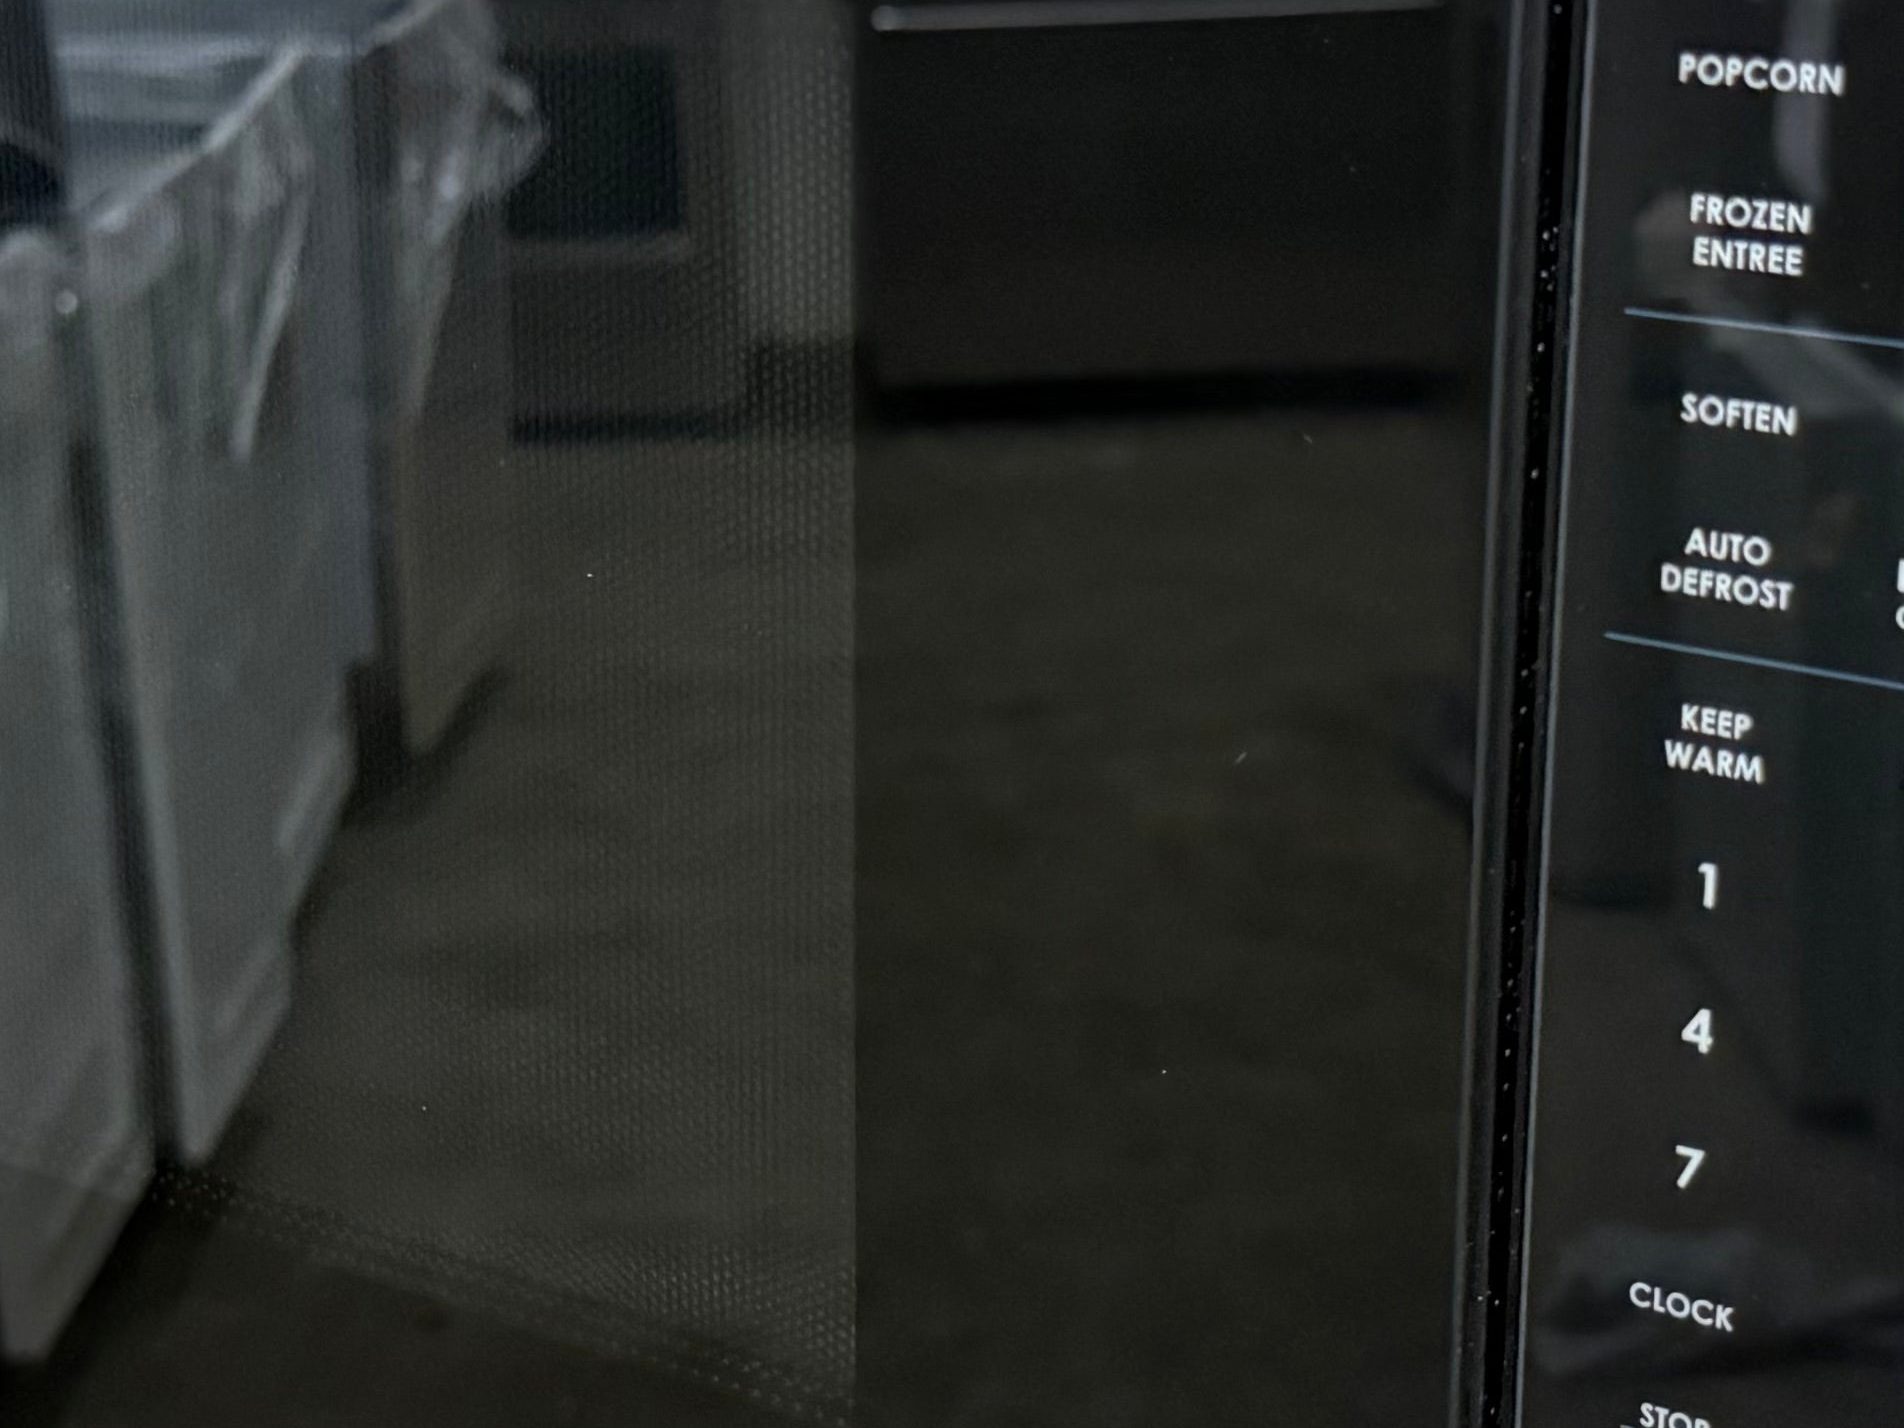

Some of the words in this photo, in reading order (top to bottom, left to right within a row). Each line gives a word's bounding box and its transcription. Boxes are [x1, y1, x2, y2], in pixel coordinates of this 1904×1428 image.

[1679, 53, 1845, 96] POPCORN
[1689, 193, 1811, 236] FROZEN
[1692, 237, 1804, 277] ENTREE
[1680, 393, 1798, 436] SOFTEN
[1684, 527, 1771, 569] AUTO
[1659, 564, 1794, 613] DEFROST
[1680, 703, 1754, 742] KEEP
[1664, 737, 1765, 785] WARM
[1697, 860, 1720, 910] 1
[1681, 1007, 1715, 1054] 4
[1674, 1145, 1706, 1189] 7
[1628, 1281, 1735, 1332] CLOCK
